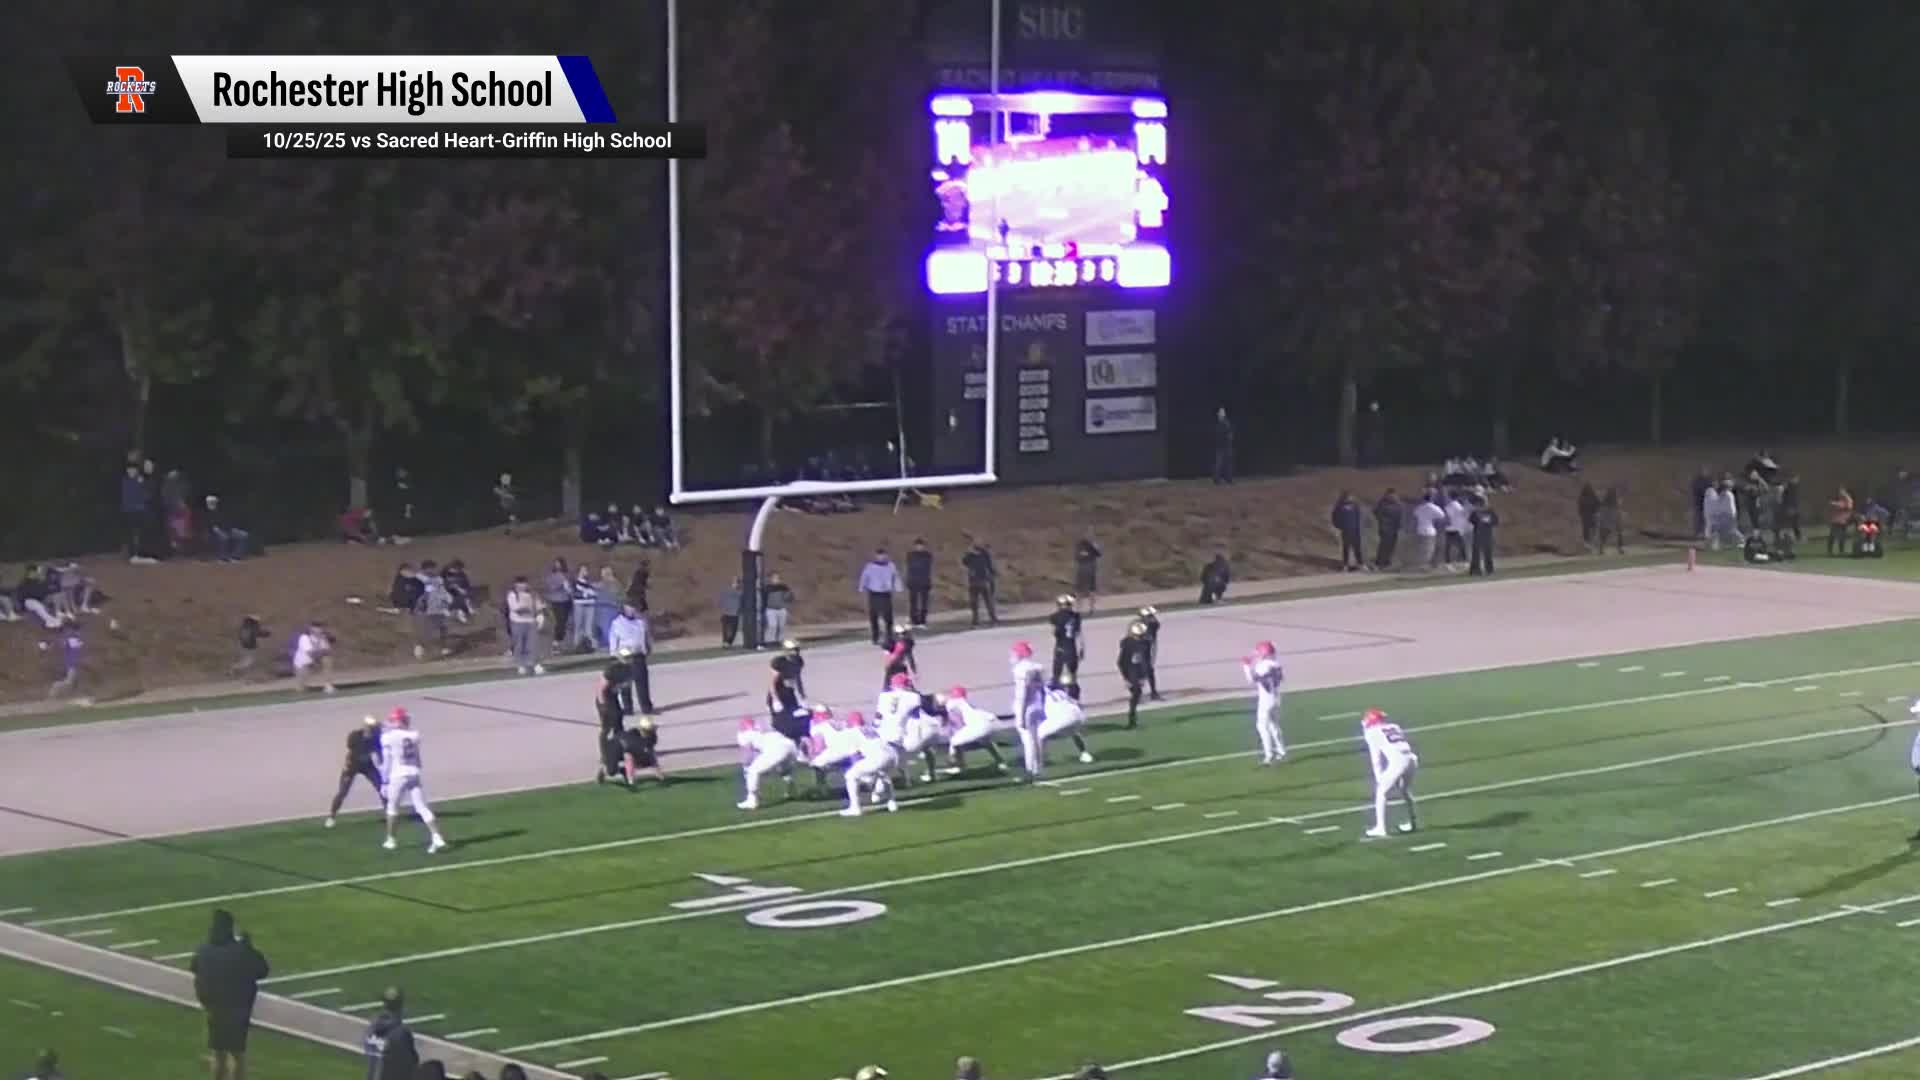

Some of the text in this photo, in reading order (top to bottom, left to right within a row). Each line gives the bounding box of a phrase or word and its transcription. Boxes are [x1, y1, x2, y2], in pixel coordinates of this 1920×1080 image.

[946, 313, 1068, 334] STAT CHAMPS
[1183, 990, 1496, 1053] 20
